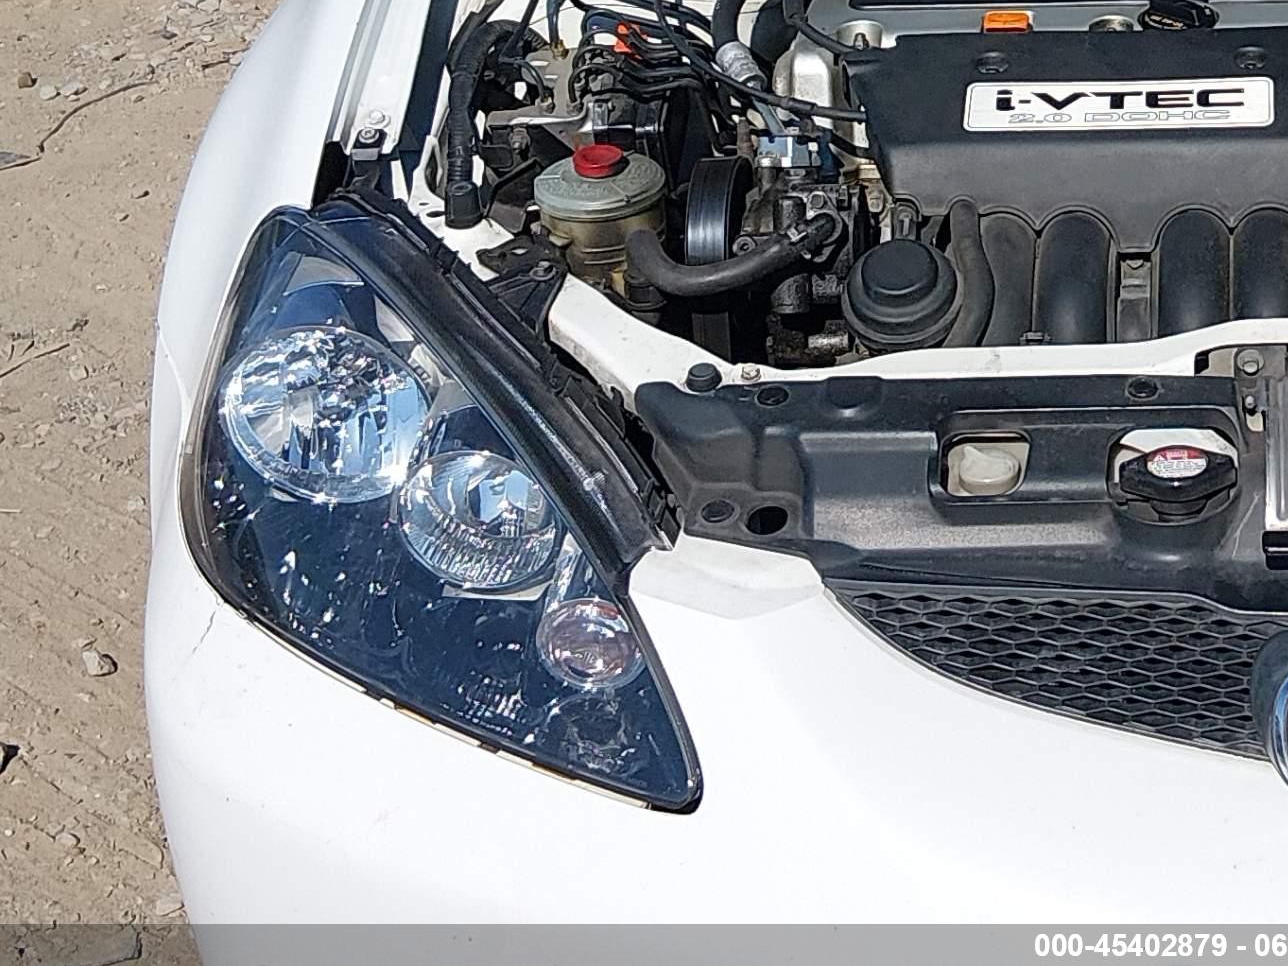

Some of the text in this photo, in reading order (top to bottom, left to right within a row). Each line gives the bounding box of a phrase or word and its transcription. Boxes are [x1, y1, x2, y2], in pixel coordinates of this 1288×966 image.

[995, 89, 1245, 111] i-VTEC
[1008, 110, 1231, 124] 2.0 DOHC
